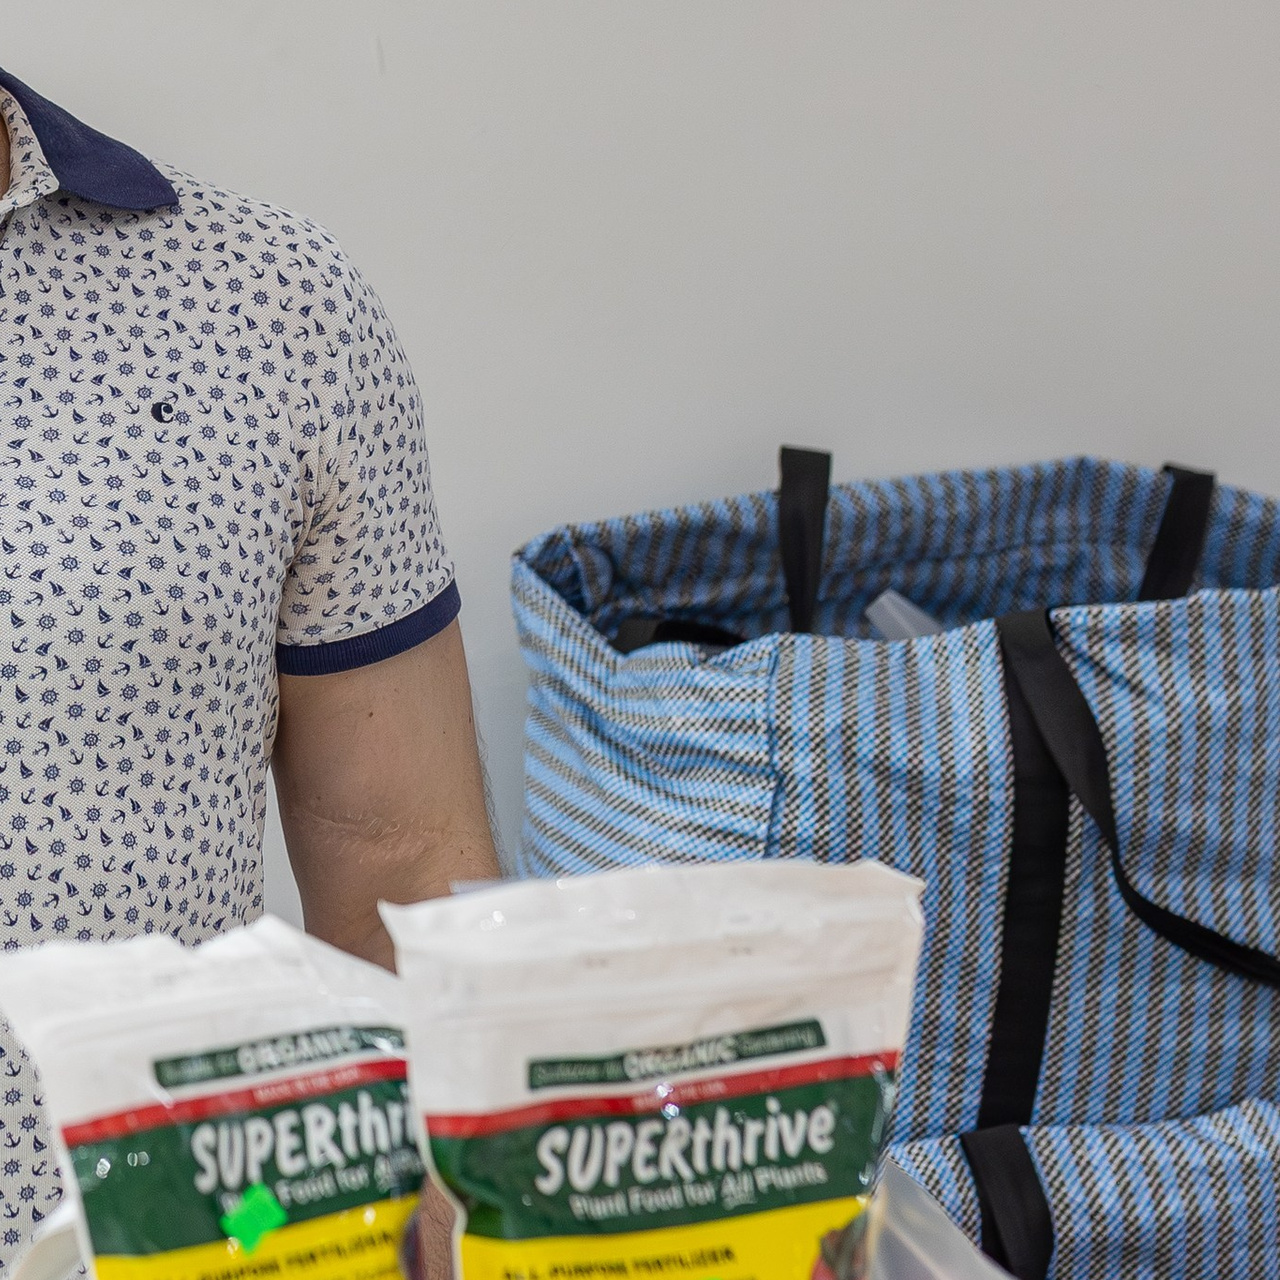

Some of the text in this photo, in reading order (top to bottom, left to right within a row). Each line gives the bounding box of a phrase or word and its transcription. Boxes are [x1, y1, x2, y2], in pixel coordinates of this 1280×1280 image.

[190, 1090, 418, 1195] SUPERthri
[534, 1095, 837, 1197] SUPERthrive
[628, 1183, 684, 1215] Food
[753, 1160, 830, 1195] Plants
